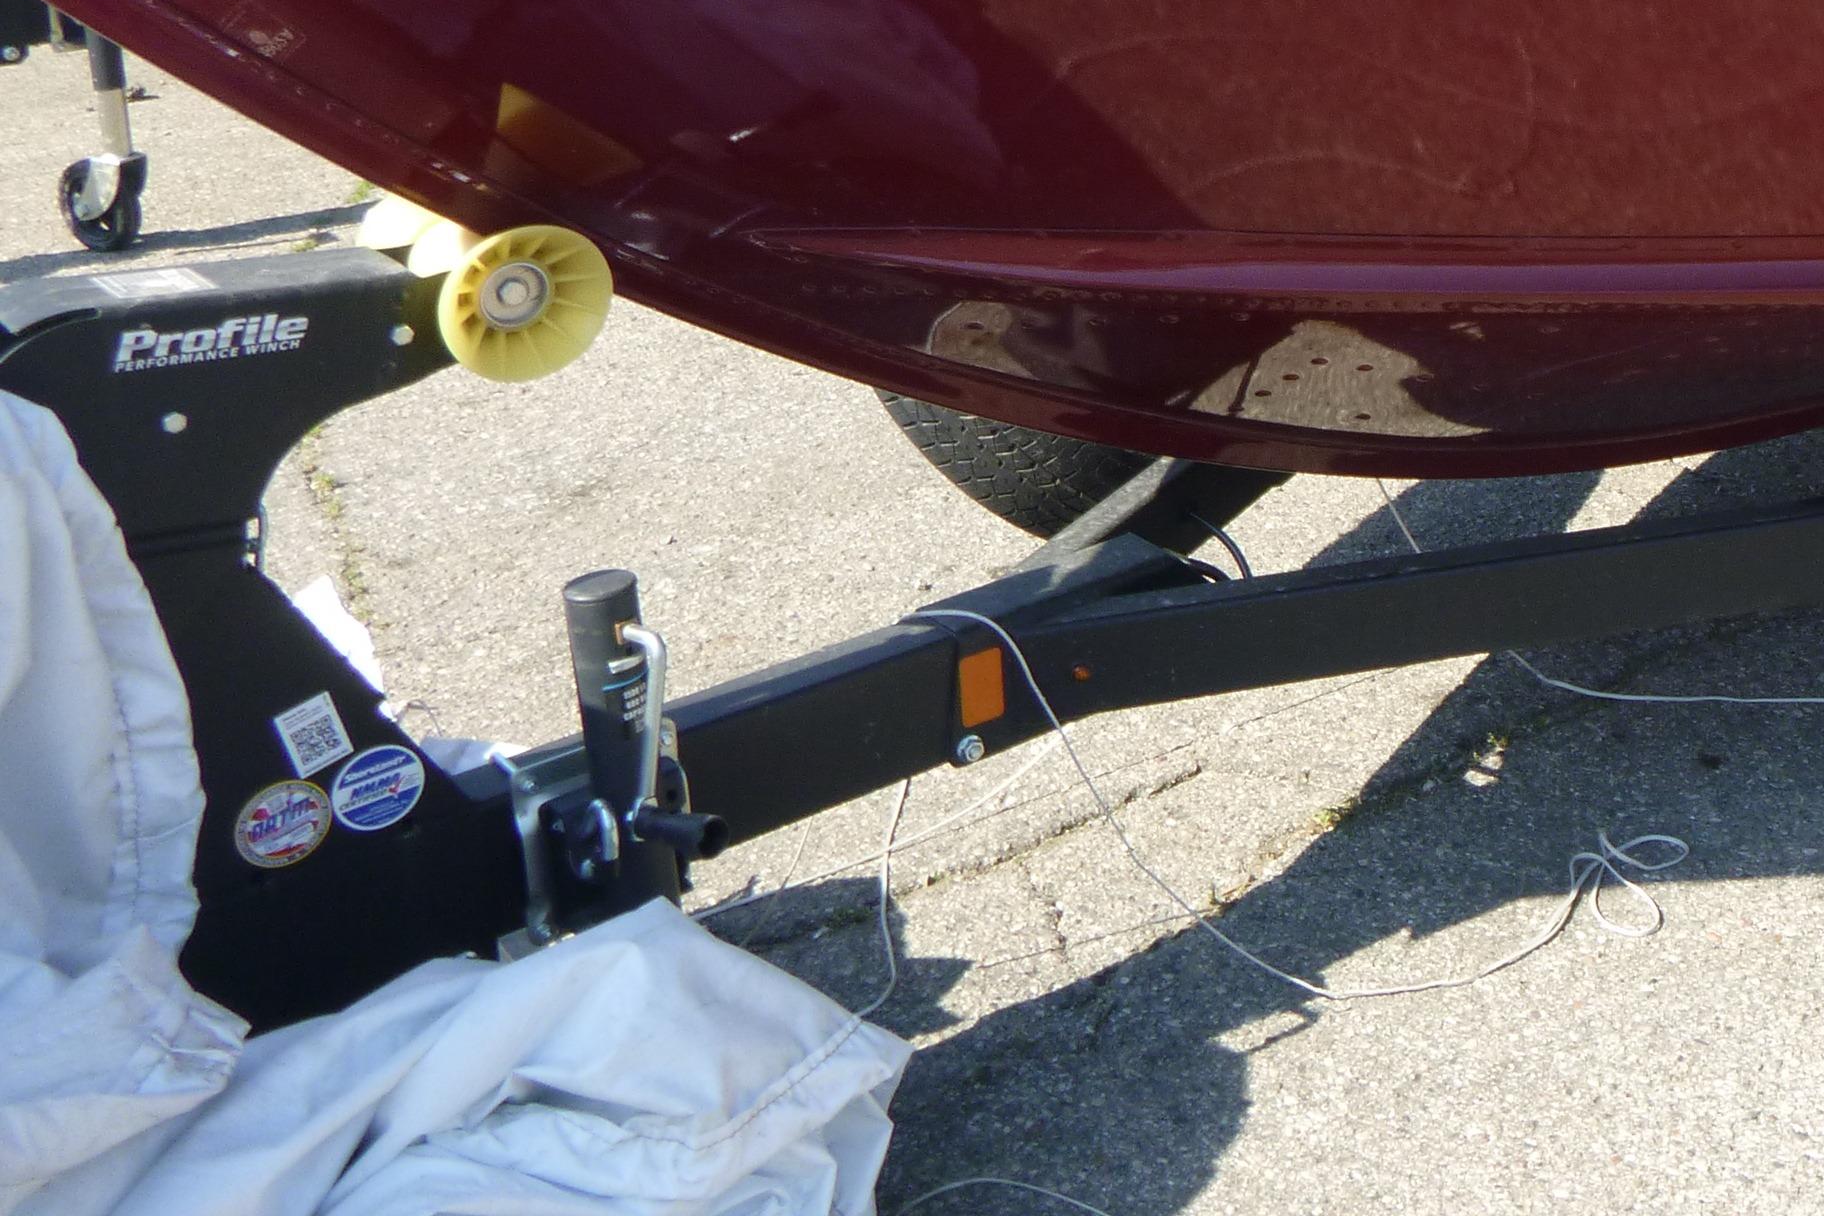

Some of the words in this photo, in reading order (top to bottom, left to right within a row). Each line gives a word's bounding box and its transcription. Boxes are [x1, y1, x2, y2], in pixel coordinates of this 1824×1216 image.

[114, 346, 239, 373] PERFORMANCE
[245, 342, 300, 355] WINCH
[117, 314, 309, 362] Profile
